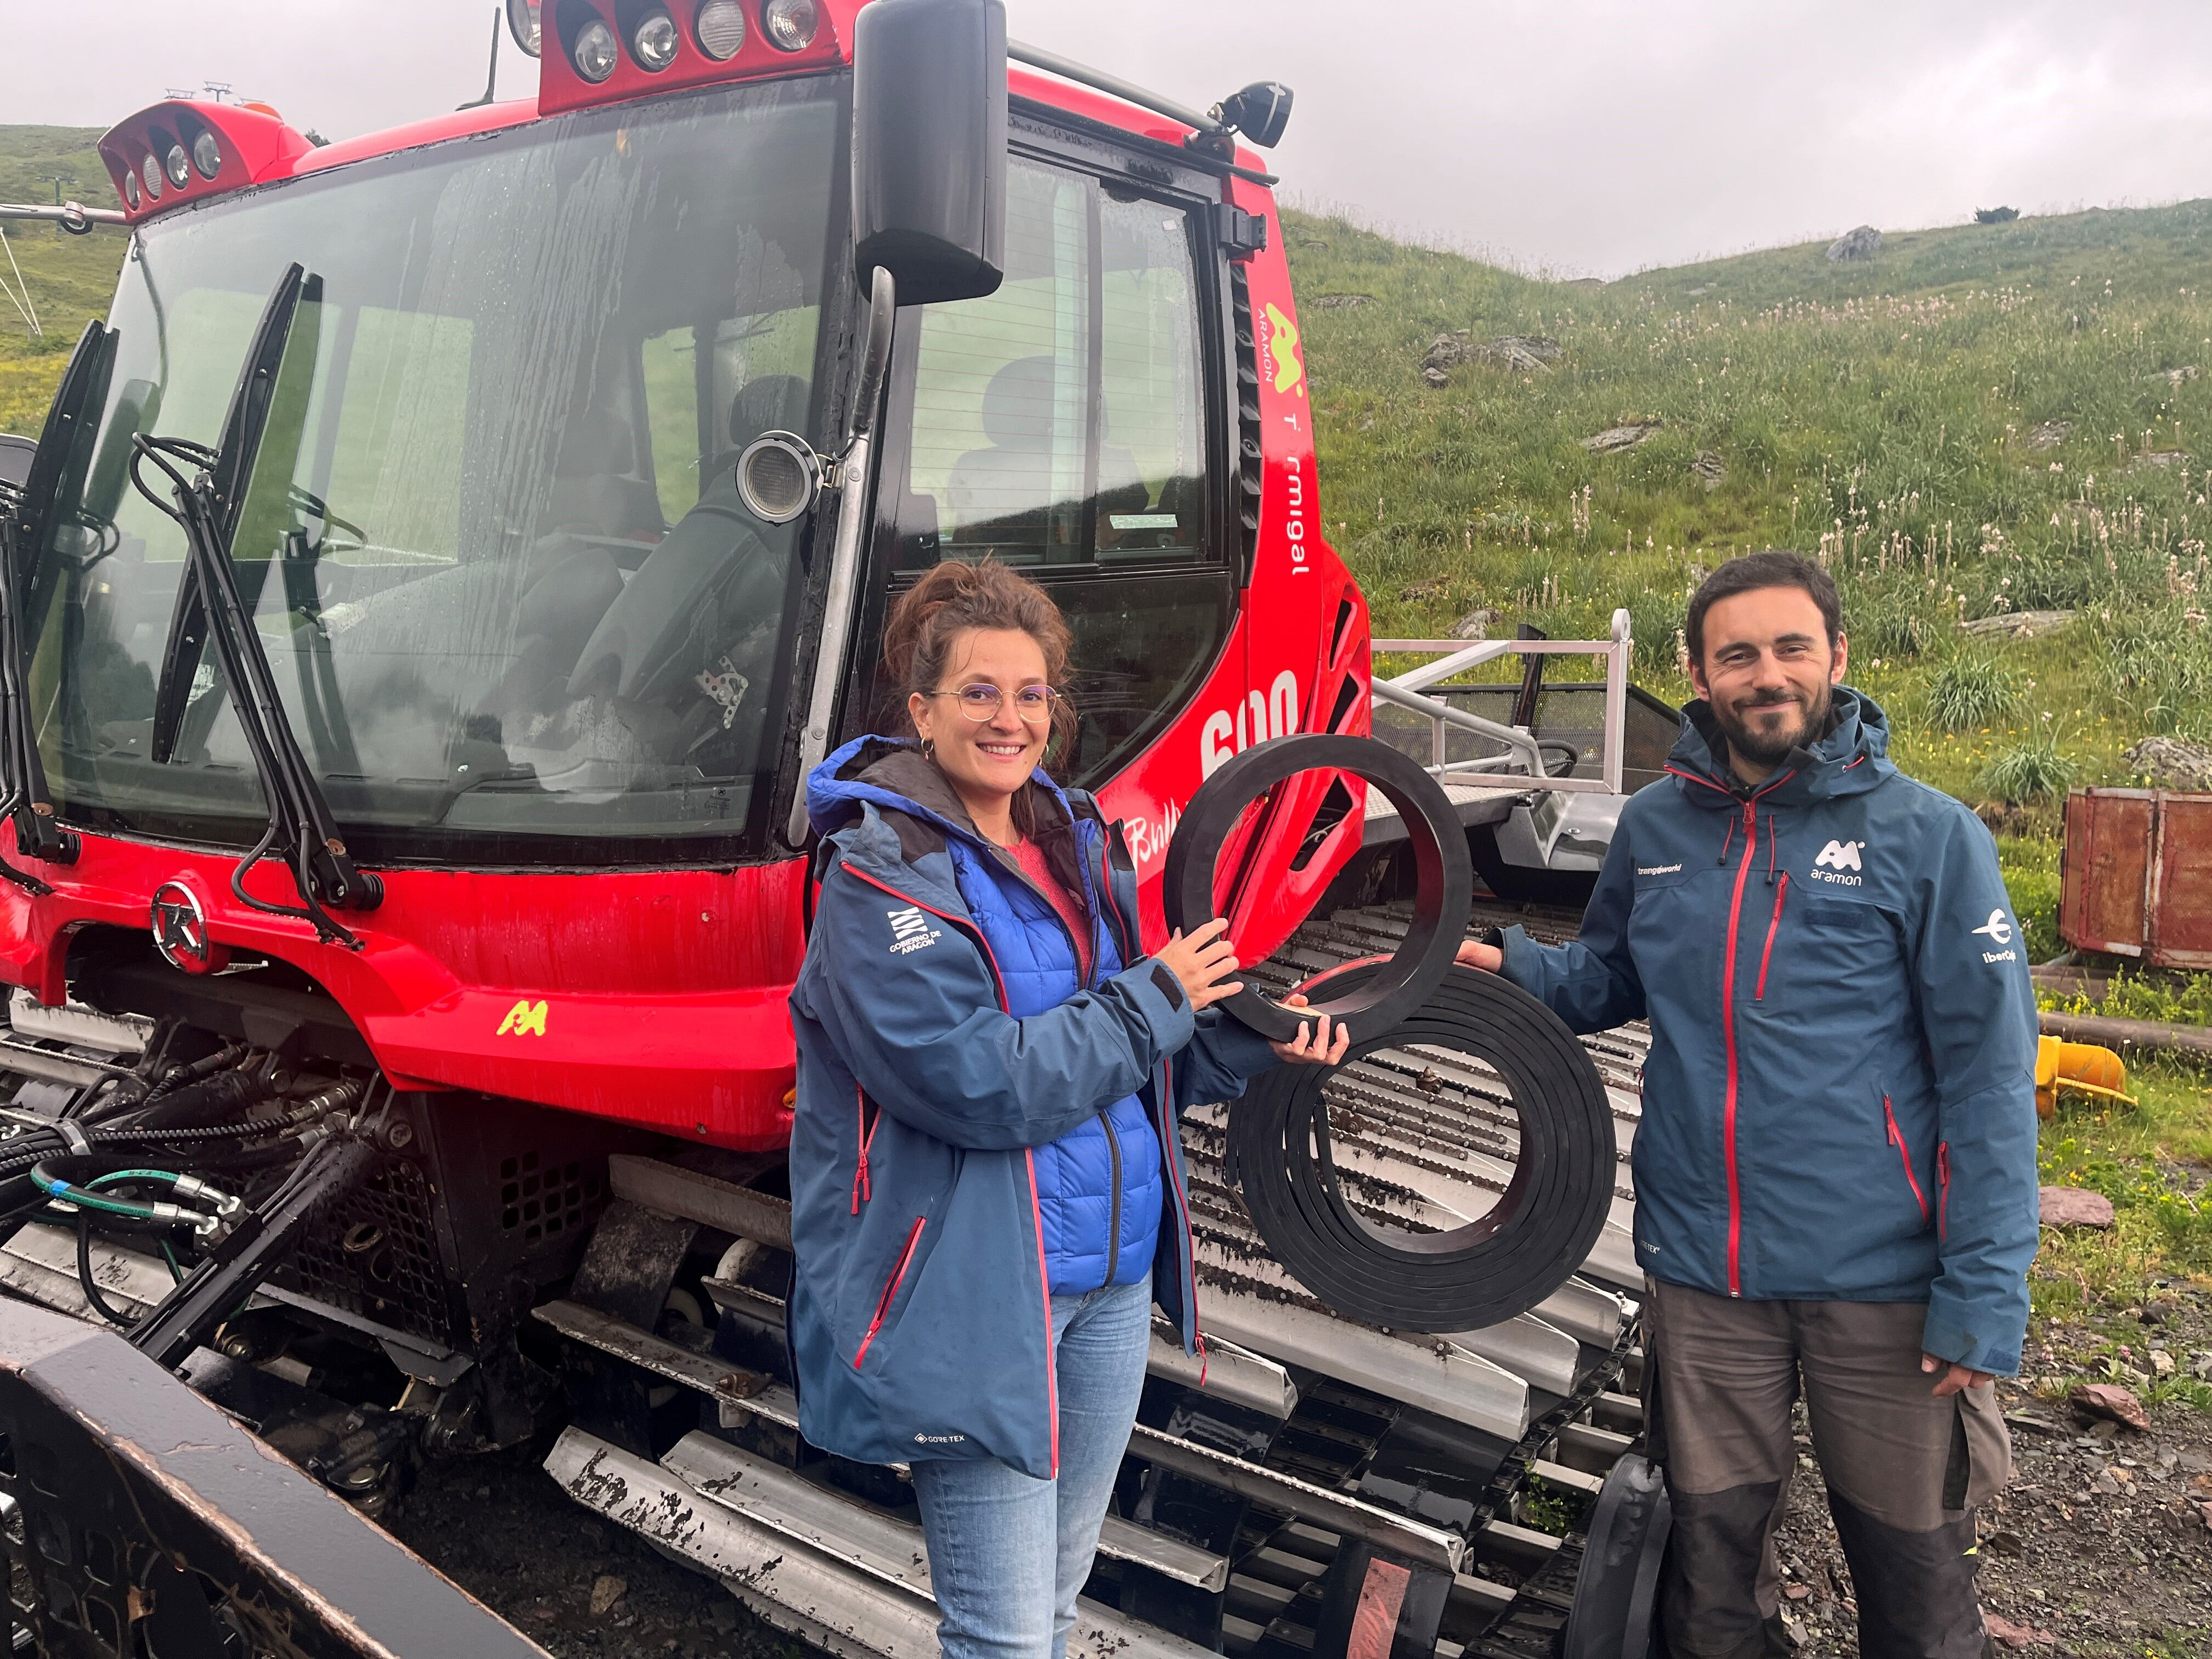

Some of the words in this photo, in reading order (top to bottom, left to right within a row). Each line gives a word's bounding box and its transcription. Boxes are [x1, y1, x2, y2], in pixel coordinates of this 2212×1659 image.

[1258, 308, 1273, 382] ARAMON
[1200, 670, 1298, 783] 600
[1810, 869, 1861, 887] aramon
[889, 933, 929, 953] GOBIERNO
